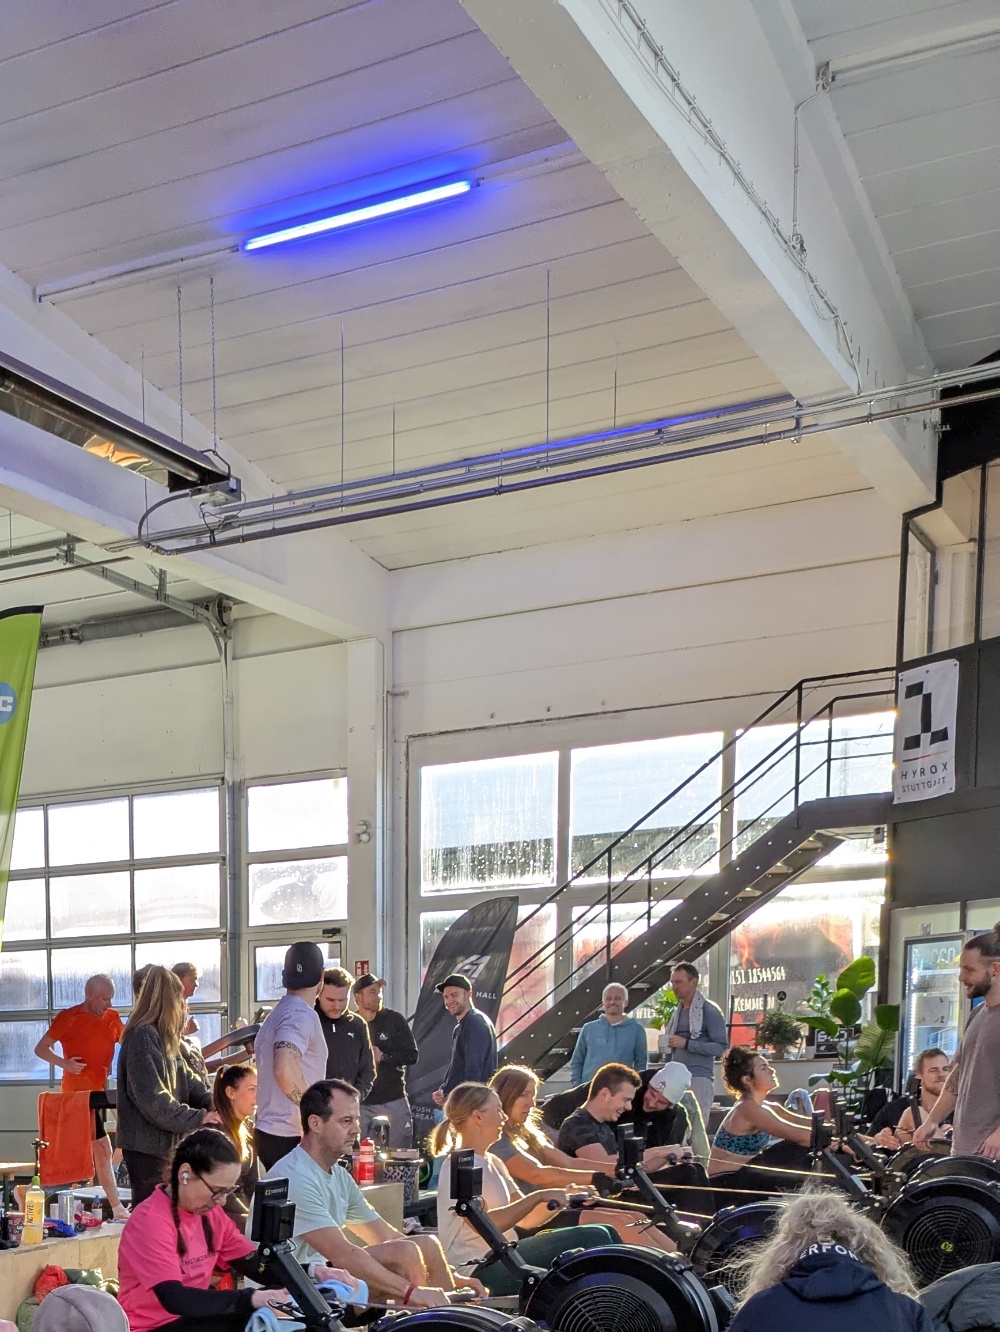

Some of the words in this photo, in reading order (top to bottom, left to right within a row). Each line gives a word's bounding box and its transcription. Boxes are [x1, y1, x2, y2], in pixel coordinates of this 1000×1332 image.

[901, 762, 948, 780] HYROX
[901, 776, 946, 793] STUTTGART
[748, 966, 786, 984] 18544564
[475, 991, 497, 1000] HALL
[734, 996, 775, 1012] KEMMEN
[26, 1203, 34, 1224] ACTIVE
